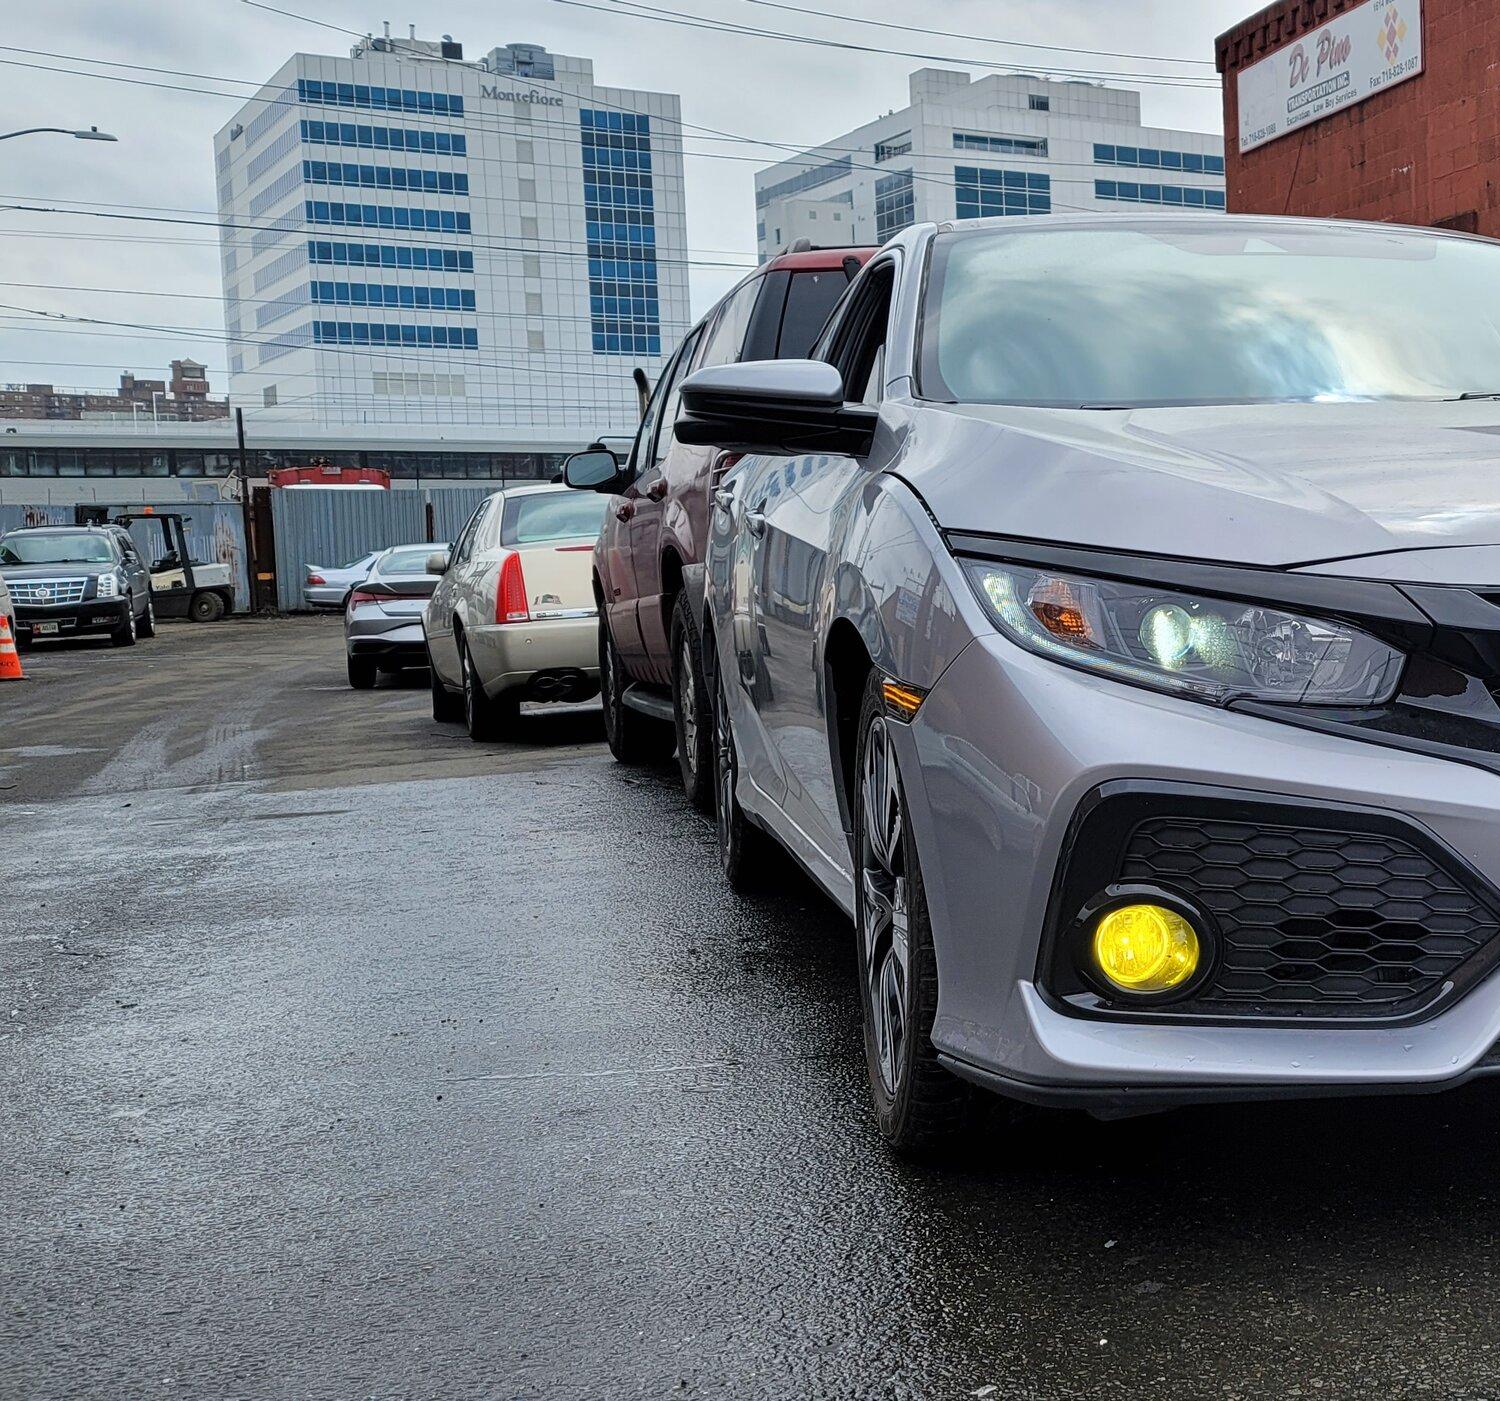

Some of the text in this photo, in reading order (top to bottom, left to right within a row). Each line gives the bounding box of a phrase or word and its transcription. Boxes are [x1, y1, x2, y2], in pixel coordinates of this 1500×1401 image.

[481, 84, 564, 107] Montefiore
[1289, 78, 1337, 112] TRANSPORTATION
[1313, 103, 1324, 113] Low
[1325, 98, 1334, 109] Boy
[1335, 88, 1357, 105] Services
